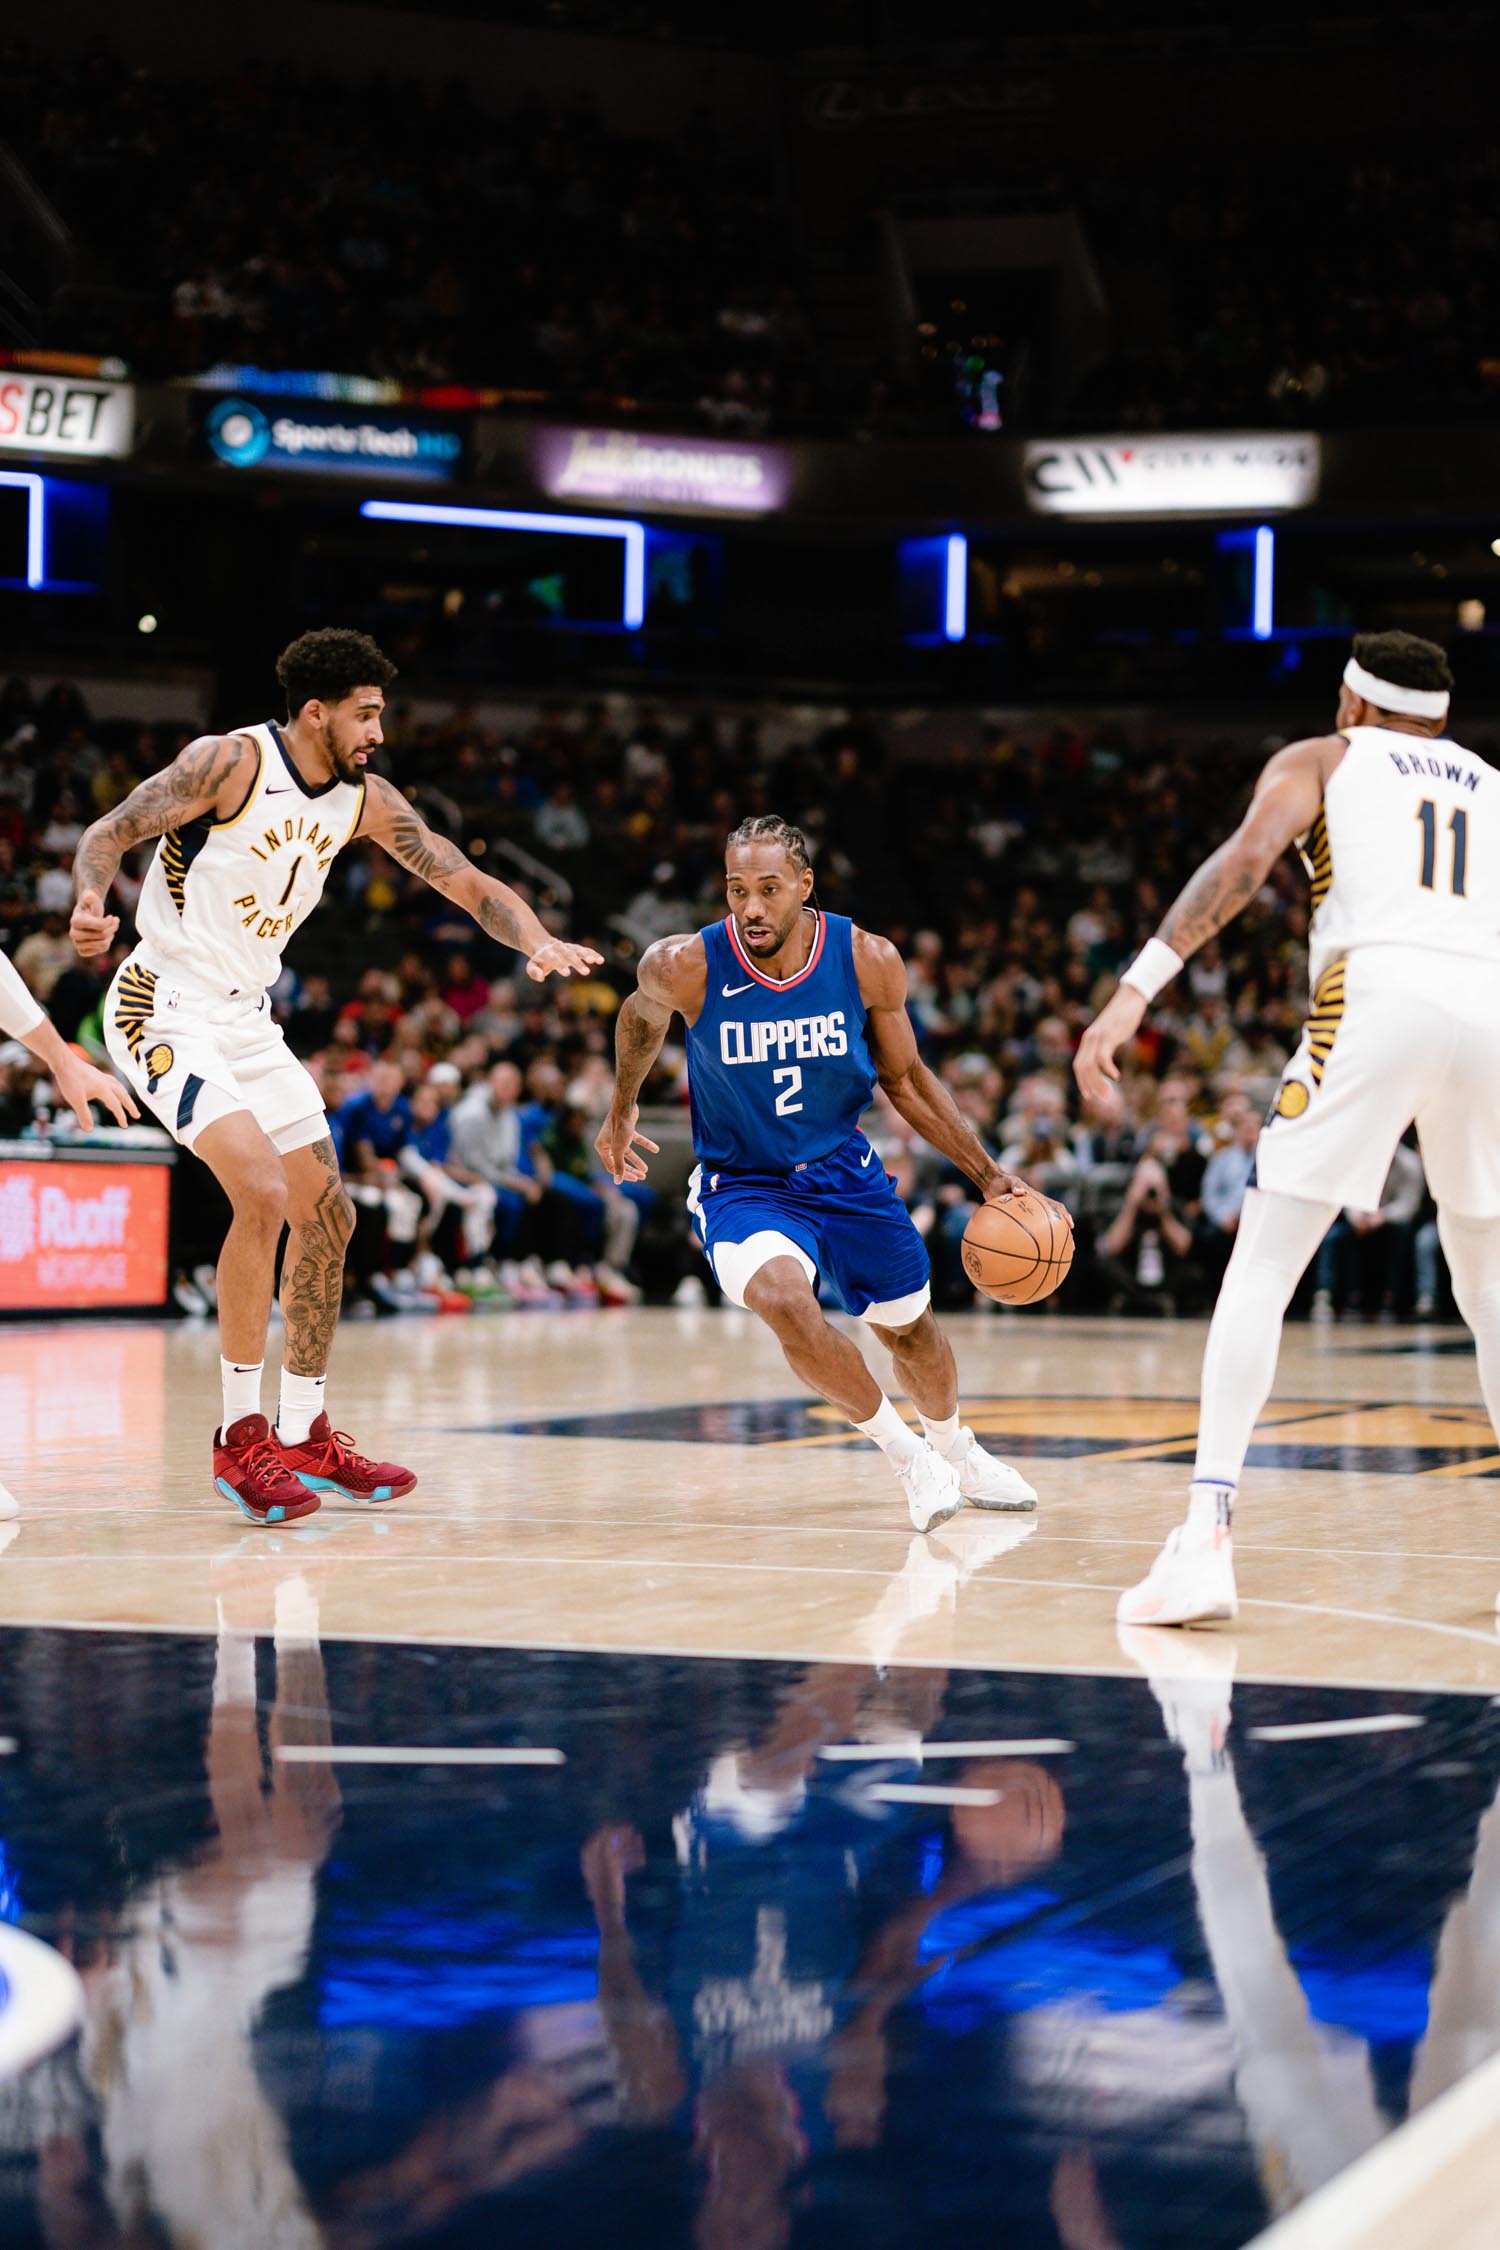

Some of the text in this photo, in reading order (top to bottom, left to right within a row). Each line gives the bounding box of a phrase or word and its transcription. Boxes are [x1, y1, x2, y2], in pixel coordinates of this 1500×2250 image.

[1390, 752, 1480, 791] BROWN
[249, 816, 334, 873] INDIANA
[1416, 798, 1467, 898] 11
[278, 854, 303, 906] 1
[232, 893, 297, 939] PACER
[720, 1011, 848, 1064] CLIPPERS
[773, 1065, 803, 1117] 2
[38, 1185, 132, 1248] Ruoff
